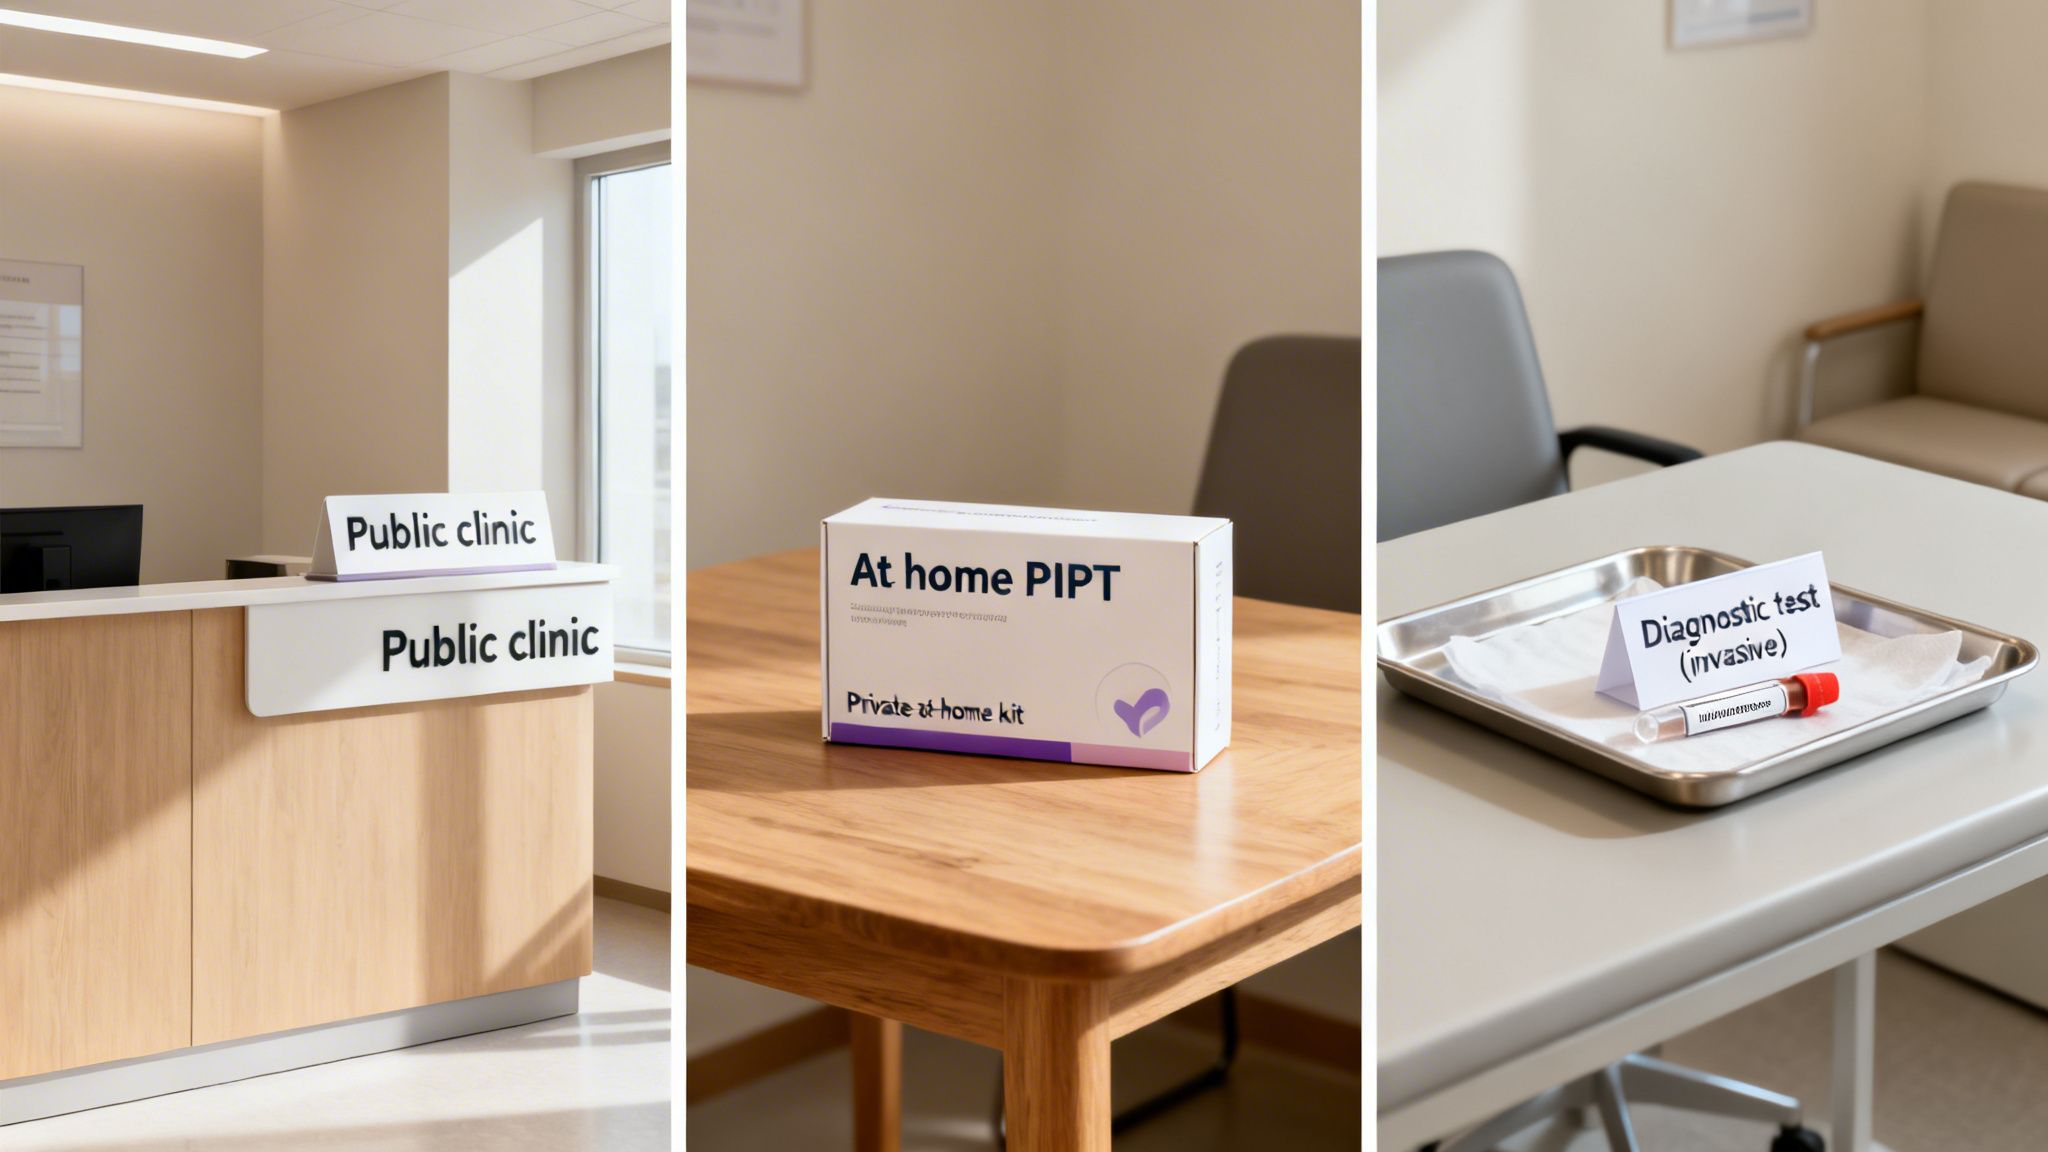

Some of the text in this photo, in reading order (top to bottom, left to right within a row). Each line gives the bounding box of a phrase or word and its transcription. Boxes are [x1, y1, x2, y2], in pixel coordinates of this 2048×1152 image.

[347, 510, 537, 551] Public clinic
[850, 552, 1121, 602] At home PIPT
[1640, 583, 1821, 649] Diagnostic test
[382, 616, 600, 672] Public clinic
[1679, 628, 1788, 684] (invasive)
[846, 691, 912, 719] Private
[999, 702, 1025, 726] kit
